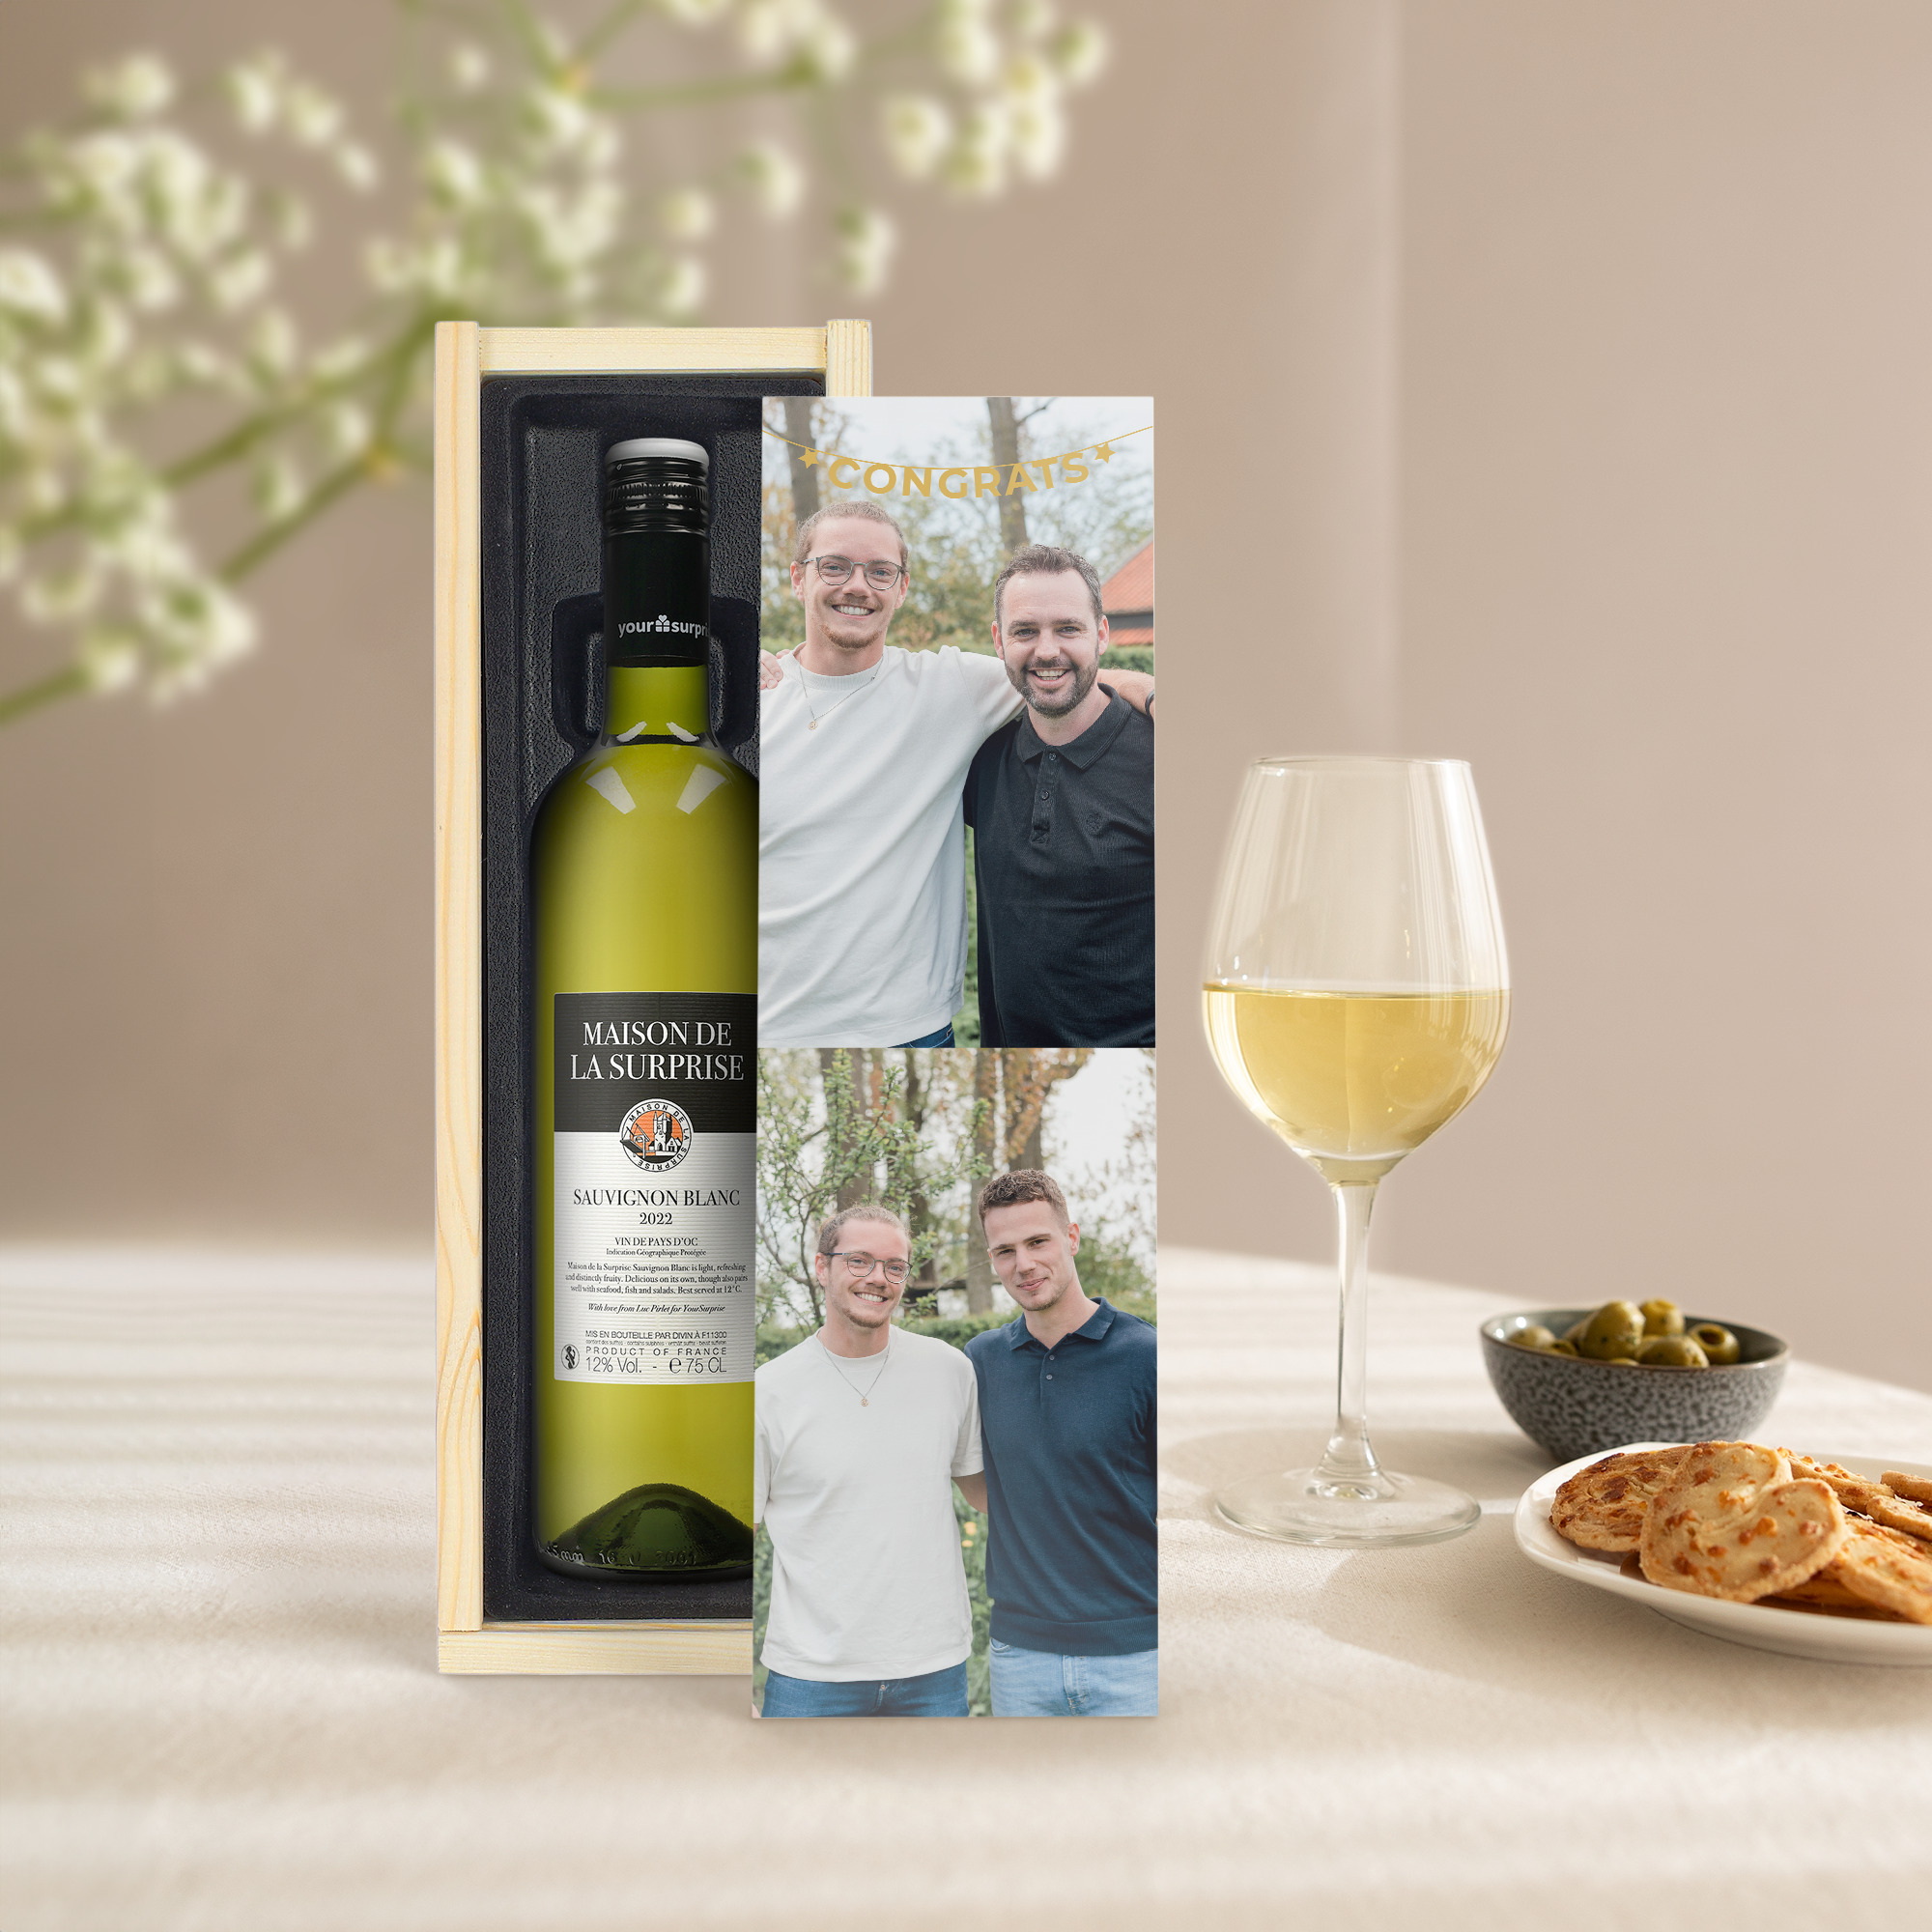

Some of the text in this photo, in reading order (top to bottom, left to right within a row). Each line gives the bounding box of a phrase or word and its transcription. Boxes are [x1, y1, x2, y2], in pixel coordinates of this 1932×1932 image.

[829, 452, 1090, 498] CONGRATS
[618, 621, 654, 639] your
[583, 1021, 732, 1046] MAISON DE
[570, 1054, 744, 1081] LA SURPRISE
[629, 1103, 690, 1171] MAISON DE LA SURPRISE
[574, 1189, 740, 1206] SAUVIGNON BLANC
[639, 1212, 672, 1225] 2022
[614, 1237, 632, 1246] VIN
[633, 1237, 647, 1246] DE
[649, 1237, 672, 1246] PAYS
[636, 1248, 680, 1258] Géographique
[680, 1248, 707, 1258] Protégée
[588, 1262, 595, 1270] de
[597, 1263, 602, 1271] la
[603, 1264, 632, 1273] Surprise
[633, 1264, 668, 1273] Sauvignon
[698, 1264, 715, 1273] light,
[717, 1264, 746, 1273] refreshing
[576, 1273, 601, 1284] distinctly
[603, 1274, 624, 1284] fruity.
[698, 1275, 721, 1285] though
[734, 1274, 748, 1284] pairs
[616, 1304, 635, 1314] from
[668, 1304, 682, 1315] for
[683, 1304, 725, 1314] YourSurprise
[694, 1330, 701, 1339] À
[585, 1347, 726, 1356] PRODUCT OF FRANCE
[585, 1356, 613, 1373] 12%
[617, 1357, 642, 1374] Vol.
[686, 1358, 704, 1374] 75
[708, 1357, 726, 1374] CL
